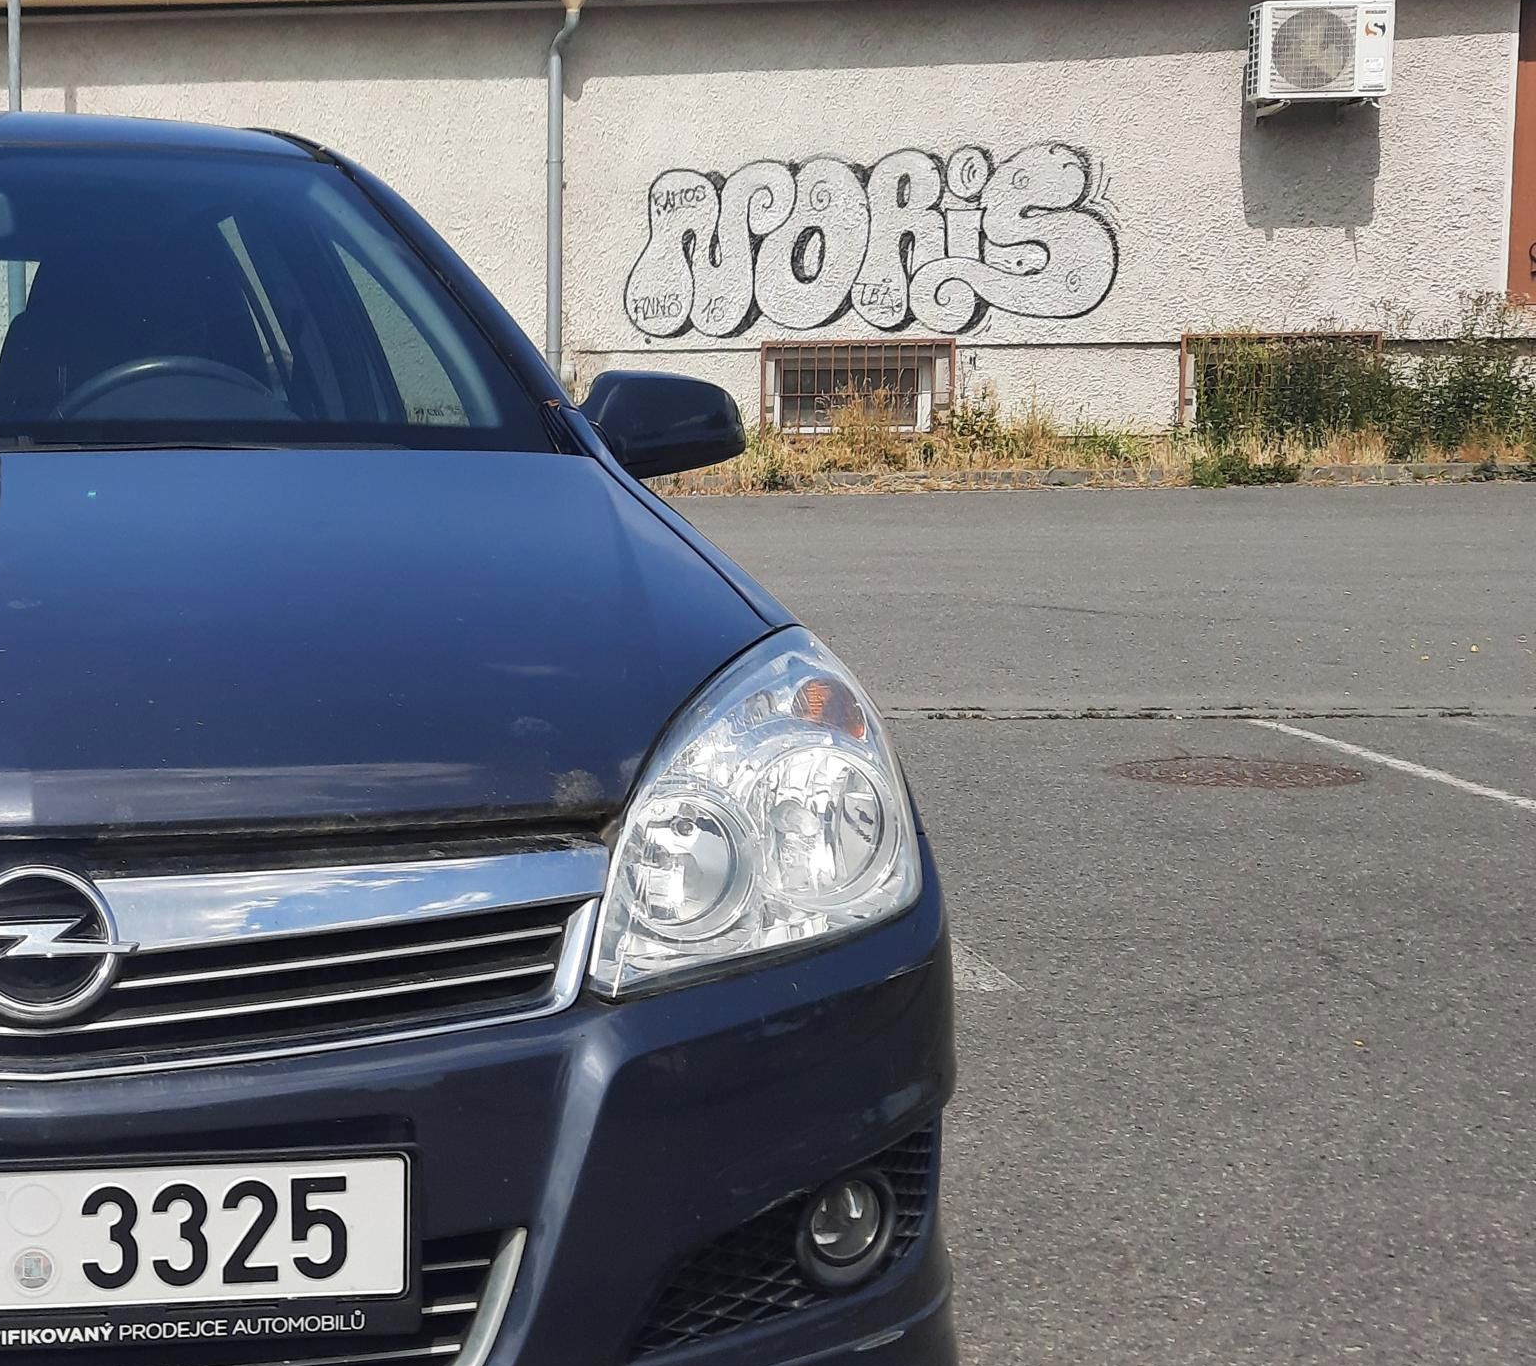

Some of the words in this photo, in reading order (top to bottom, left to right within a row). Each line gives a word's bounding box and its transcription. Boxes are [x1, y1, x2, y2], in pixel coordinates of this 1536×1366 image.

[81, 1176, 348, 1288] 3325
[119, 1321, 228, 1341] PRODEJCE
[232, 1310, 365, 1335] AUTOMOBILŮ
